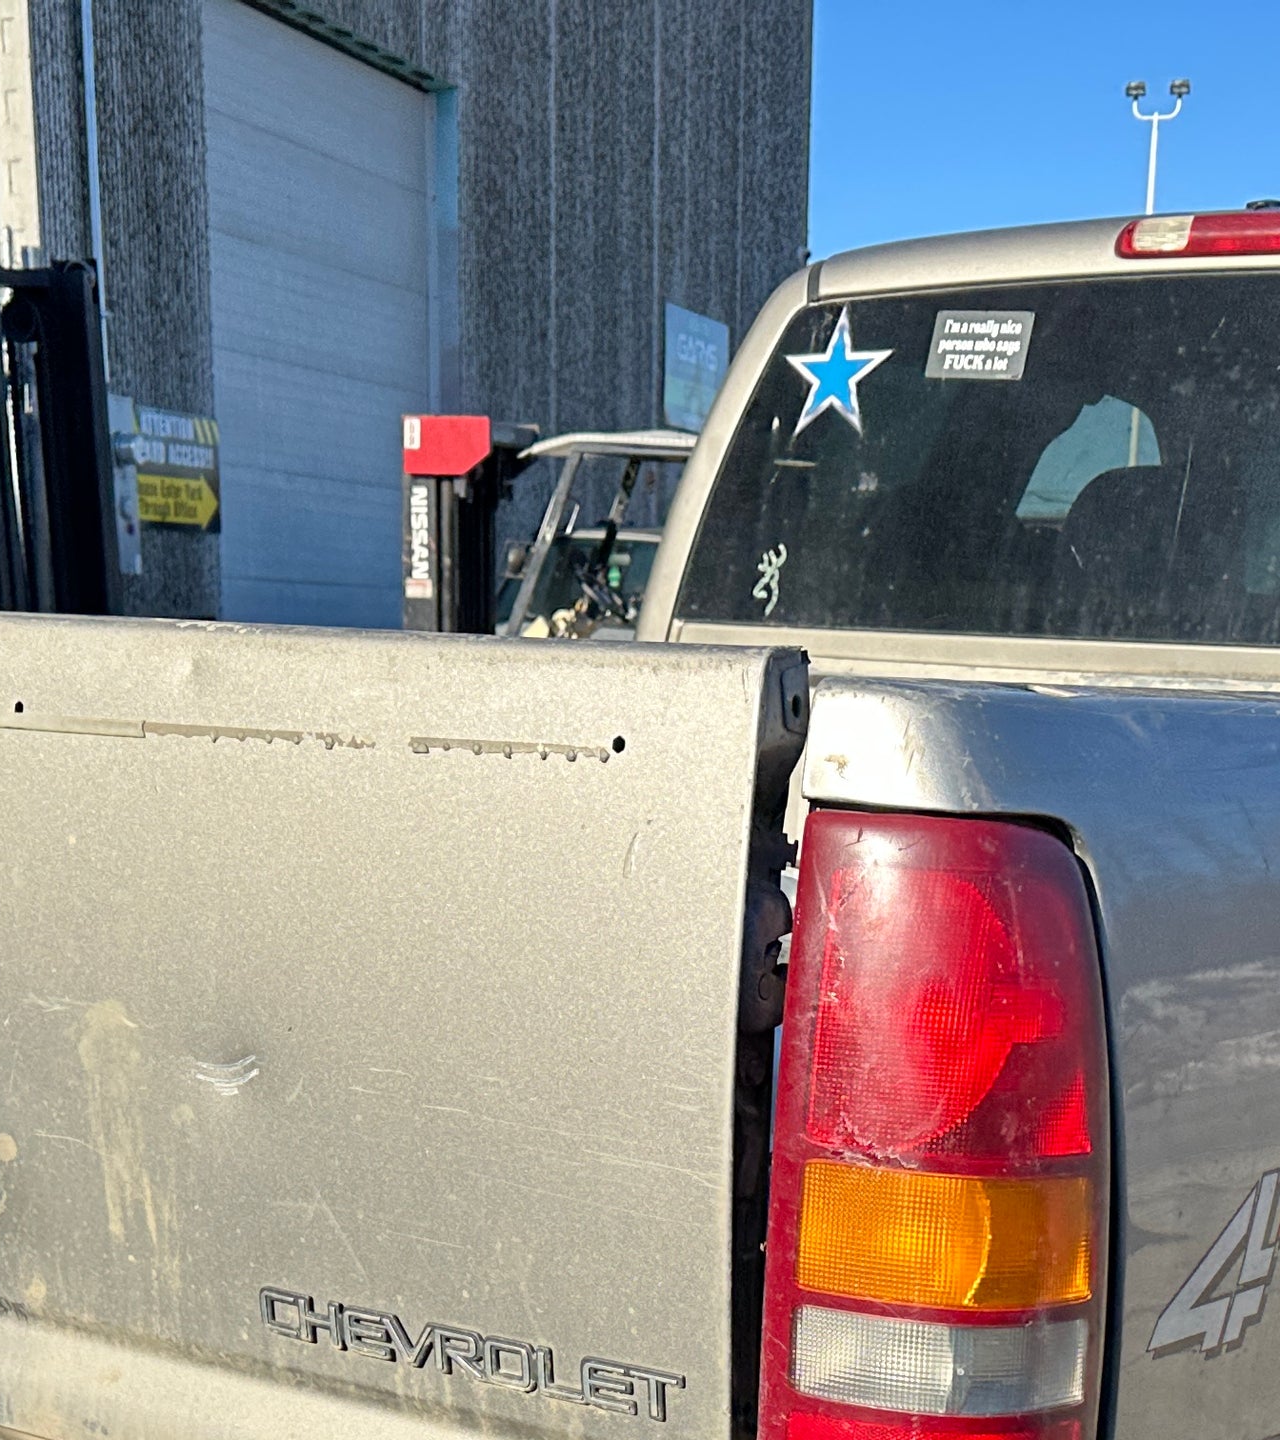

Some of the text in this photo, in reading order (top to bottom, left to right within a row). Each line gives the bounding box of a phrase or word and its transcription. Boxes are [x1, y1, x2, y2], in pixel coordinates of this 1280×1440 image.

[969, 319, 1000, 338] really
[1000, 319, 1023, 335] nice
[937, 337, 1021, 356] person who says
[943, 354, 985, 371] FUCK
[992, 356, 1009, 371] lot
[410, 484, 430, 580] NISSAN
[258, 1285, 687, 1423] CHEVROLET
